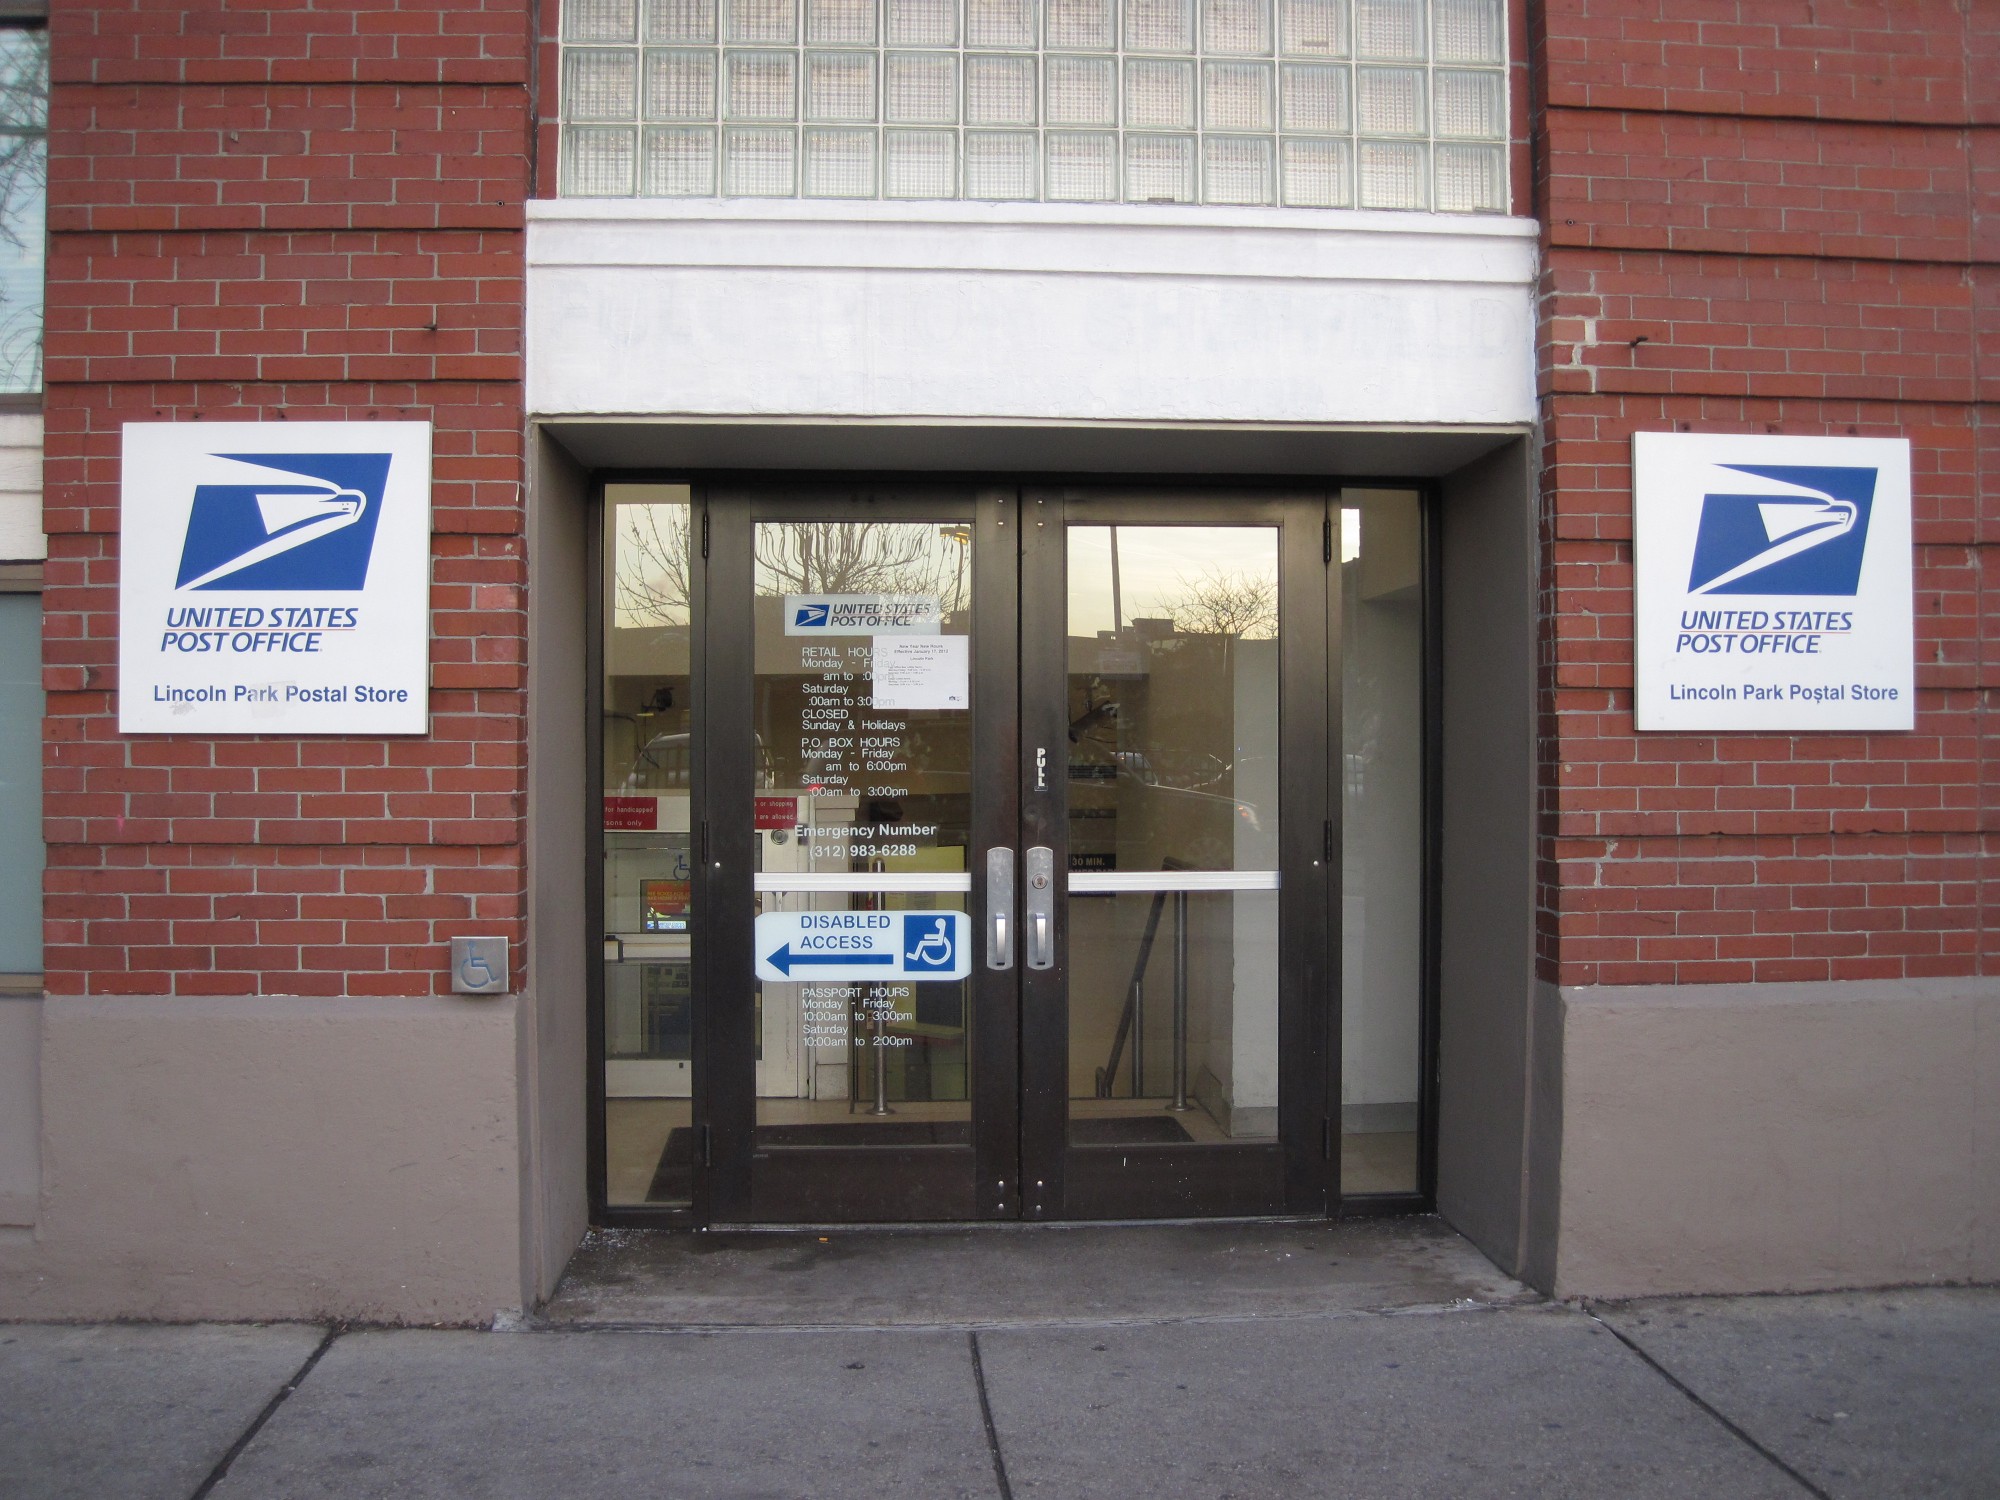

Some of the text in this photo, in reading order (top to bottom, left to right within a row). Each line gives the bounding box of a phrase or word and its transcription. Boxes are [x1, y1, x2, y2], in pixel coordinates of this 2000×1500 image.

[833, 604, 930, 614] UNITED STATES
[166, 607, 359, 628] UNITED STATES
[830, 616, 912, 626] POST OFFICE
[1680, 610, 1853, 631] UNITED STATES
[160, 632, 323, 653] POST OFFICE
[1675, 634, 1822, 653] POST OFFICE
[801, 647, 888, 657] RETAIL HOURS
[801, 658, 843, 670] Monday
[863, 658, 896, 670] Friday
[823, 673, 840, 681] am
[843, 671, 854, 681] to
[153, 685, 409, 702] Lincoln Park Postal Store
[802, 683, 849, 695] Saturday
[1669, 684, 1899, 701] Lincoln Park Postal Store
[843, 696, 854, 706] to
[801, 709, 849, 719] CLOSED
[802, 720, 906, 731] Sunday & Holidays
[801, 738, 901, 748] P.O. BOX HOURS
[801, 749, 843, 759] Monday
[861, 748, 894, 760] Friday
[825, 761, 907, 773] am to 6:00pm
[1036, 748, 1046, 787] PULL
[802, 774, 849, 786] Saturday
[850, 786, 861, 796] to
[867, 786, 908, 798] 3:00pm
[794, 823, 937, 839] Emergency Number
[809, 844, 917, 859] (312) 983-6288
[1086, 858, 1105, 866] MIN.
[800, 915, 891, 929] DISABLED
[800, 936, 873, 949] ACCESS
[802, 987, 910, 998] PASSPORT HOURS
[802, 999, 843, 1010] Monday
[863, 998, 895, 1010] Friday
[803, 1010, 913, 1022] 10:00am to 3:00pm
[803, 1024, 849, 1036] Saturday
[803, 1035, 913, 1047] 10:00am to 2:00pm
